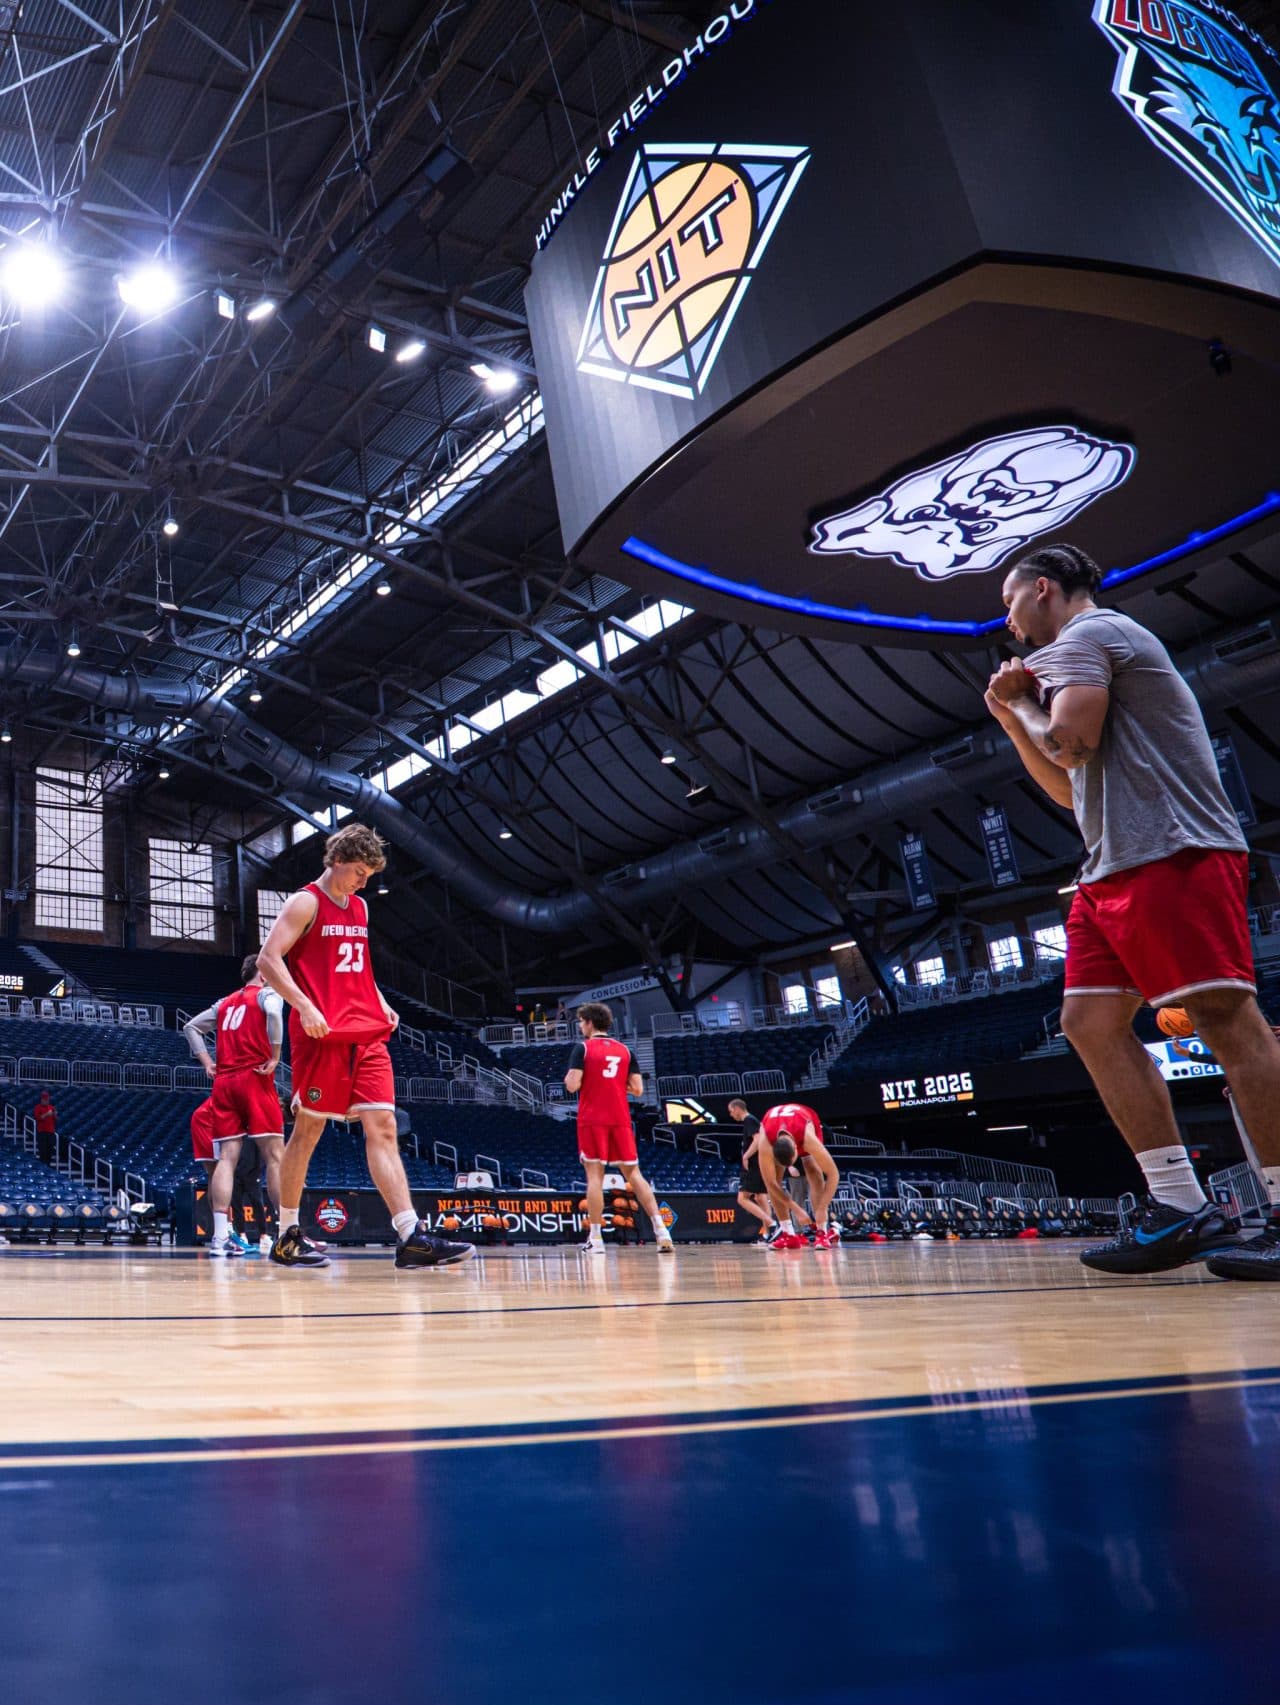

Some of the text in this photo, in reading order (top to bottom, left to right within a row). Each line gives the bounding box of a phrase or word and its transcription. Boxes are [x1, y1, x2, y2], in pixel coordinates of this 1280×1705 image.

[1110, 0, 1270, 95] LOBOS
[535, 147, 601, 250] HINKLE
[611, 185, 735, 338] NIT
[321, 924, 344, 937] NEW
[335, 942, 365, 973] 23
[591, 978, 652, 1000] CONCESSIONS
[222, 1004, 246, 1031] 10
[602, 1056, 621, 1078] 3
[880, 1072, 973, 1102] NIT 2026
[900, 1095, 956, 1107] INDIANAPOLIS
[525, 1200, 548, 1214] AND
[551, 1200, 573, 1214] NIT
[706, 1209, 735, 1223] INDY
